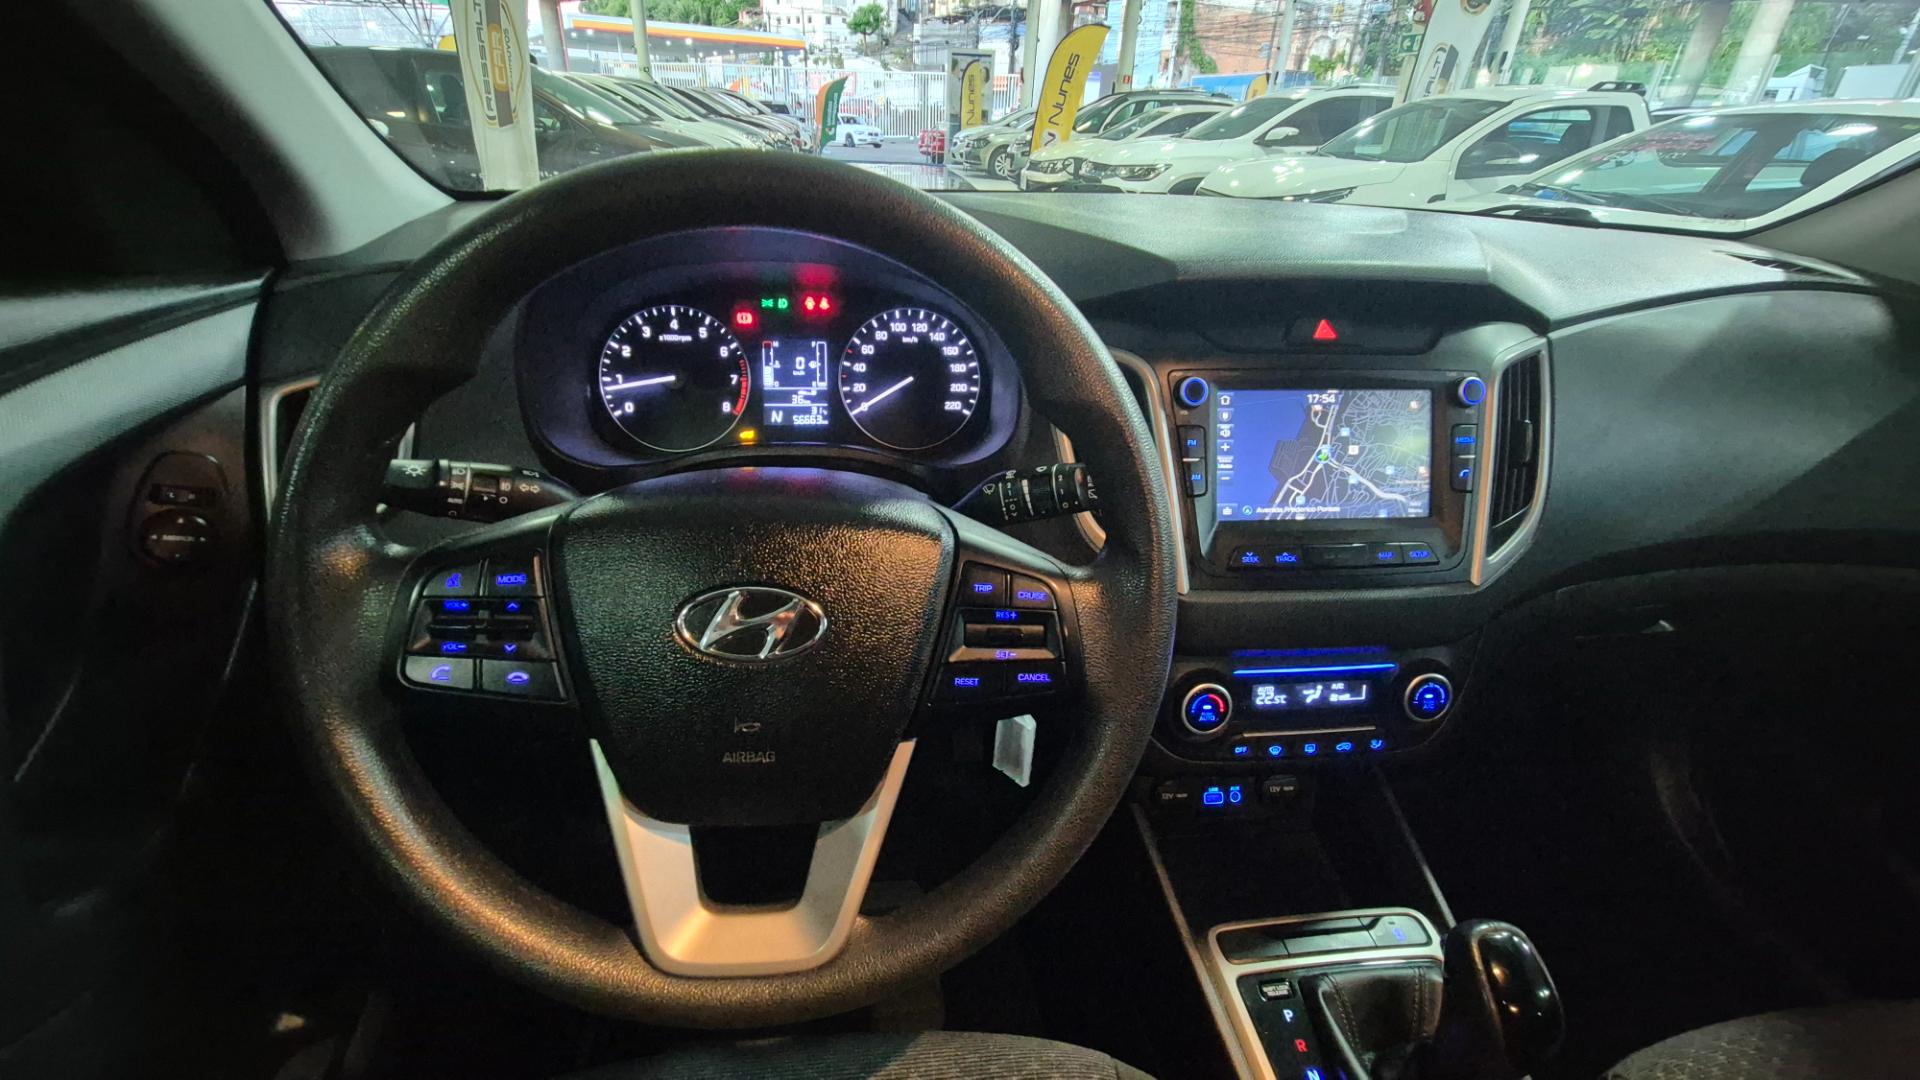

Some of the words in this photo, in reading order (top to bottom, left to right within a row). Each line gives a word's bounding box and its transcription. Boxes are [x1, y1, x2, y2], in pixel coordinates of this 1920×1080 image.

[1048, 52, 1080, 126] Nunes
[670, 319, 679, 330] 4
[890, 322, 907, 332] 100
[912, 323, 928, 333] 120
[642, 326, 651, 338] 3
[699, 327, 708, 338] 5
[875, 331, 888, 340] 80
[929, 332, 945, 342] 140
[622, 345, 631, 357] 2
[720, 346, 729, 357] 6
[861, 345, 874, 354] 60
[942, 346, 959, 355] 160
[795, 356, 805, 370] 0
[852, 363, 866, 372] 40
[950, 364, 966, 373] 180
[615, 374, 623, 385] 1
[730, 375, 738, 385] 7
[853, 383, 866, 392] 20
[950, 383, 967, 392] 200
[1307, 394, 1336, 403] 17:54
[625, 402, 634, 413] 0
[723, 402, 731, 413] 8
[944, 401, 961, 410] 220
[771, 410, 783, 423] N
[1275, 555, 1297, 563] TRACK
[497, 575, 526, 584] MODE
[974, 584, 993, 592] TRIP
[1017, 592, 1047, 600] CRUISE
[954, 678, 979, 686] RESET
[1017, 674, 1051, 682] CANCEL
[722, 751, 776, 763] AIRBAG
[1283, 1009, 1293, 1022] P
[1295, 1039, 1308, 1052] R
